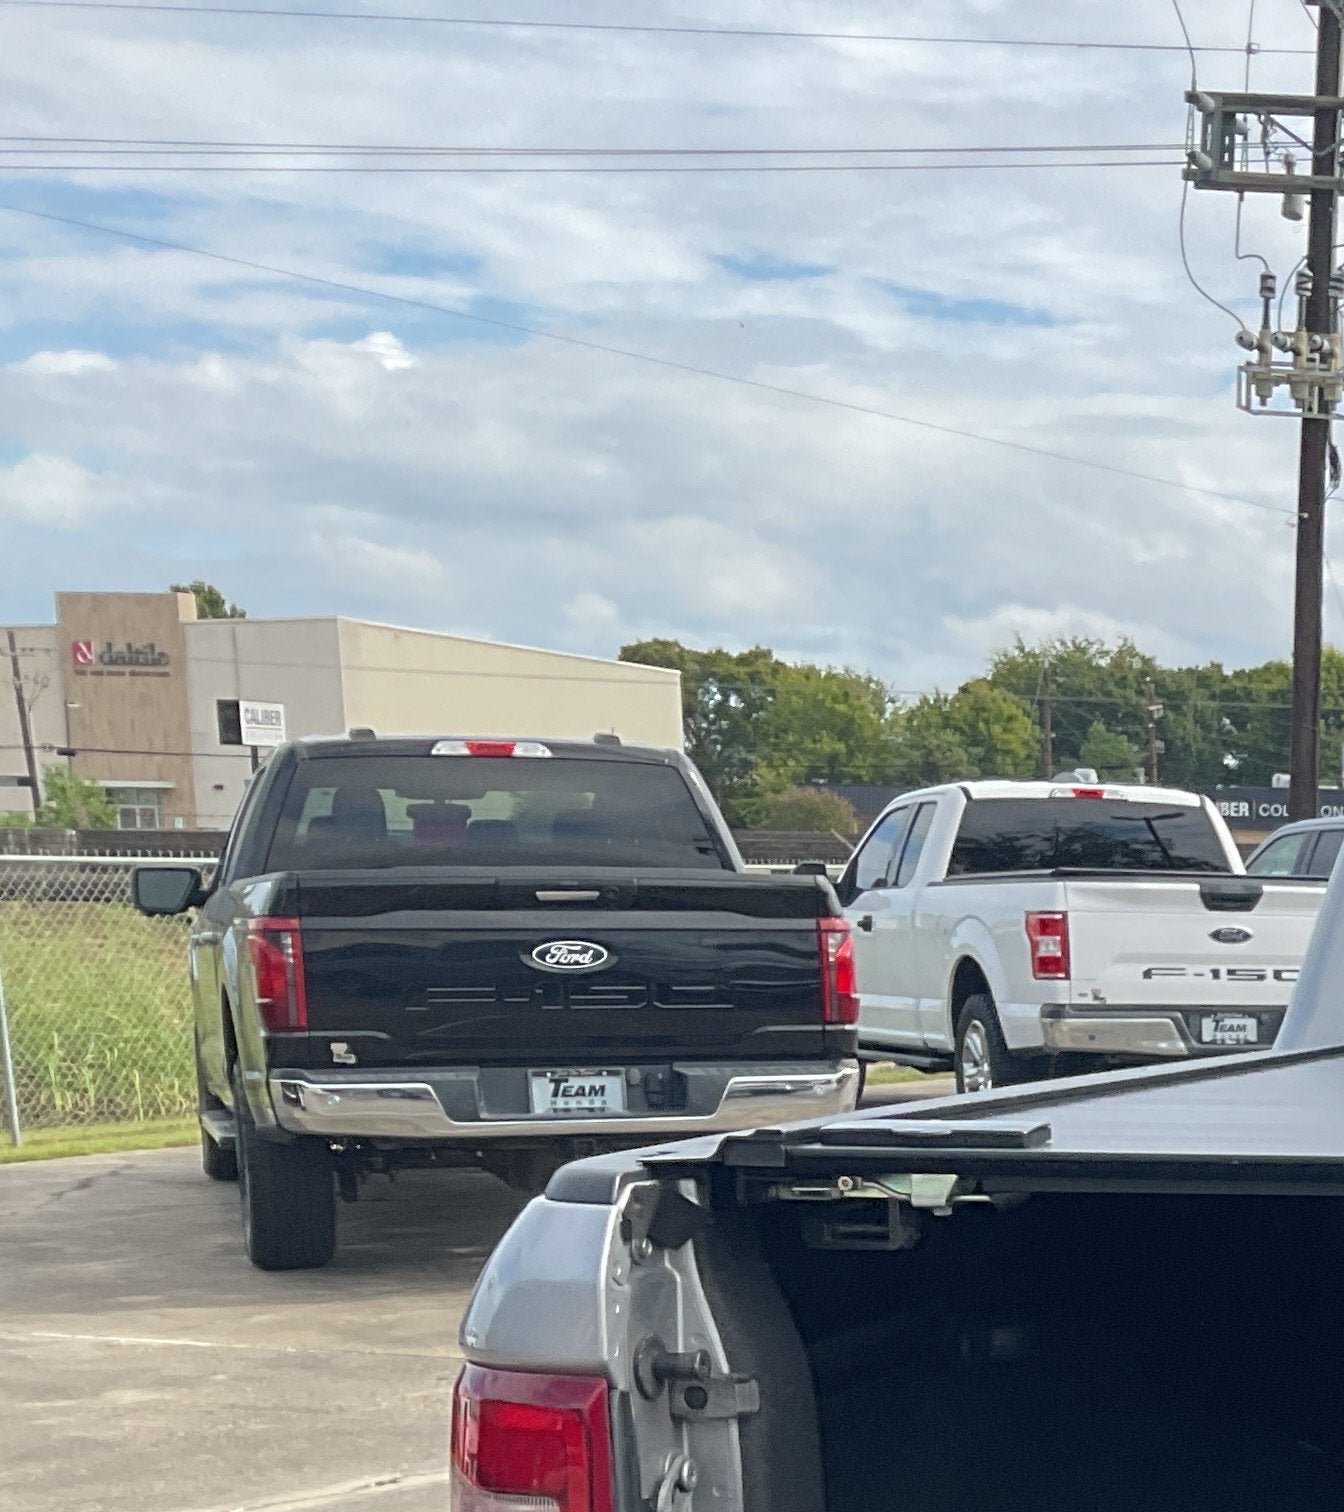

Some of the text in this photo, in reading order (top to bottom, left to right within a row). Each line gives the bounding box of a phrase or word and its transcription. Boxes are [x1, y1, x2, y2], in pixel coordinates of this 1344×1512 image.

[545, 944, 593, 964] Ford
[1213, 1017, 1247, 1034] TEAM
[548, 1078, 606, 1098] TEAM
